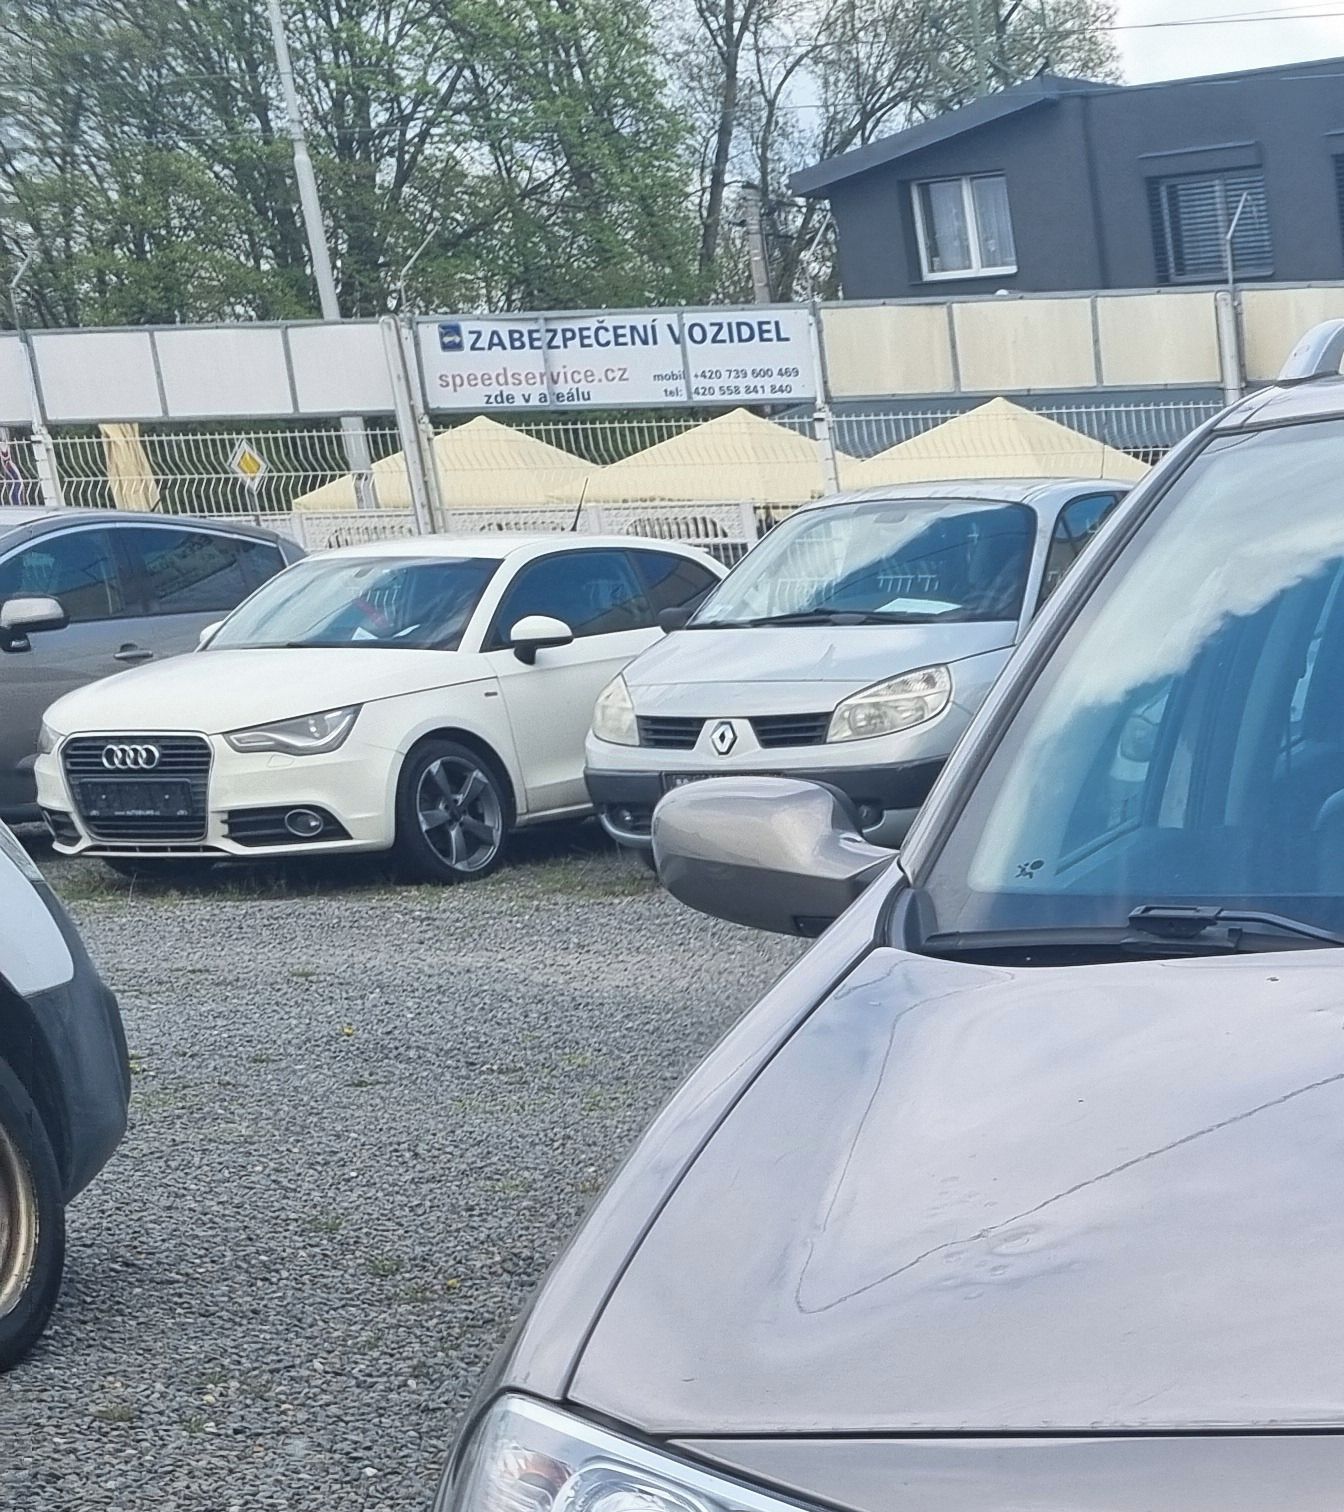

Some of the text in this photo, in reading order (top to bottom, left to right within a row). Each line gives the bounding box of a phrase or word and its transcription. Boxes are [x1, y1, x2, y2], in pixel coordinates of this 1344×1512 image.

[468, 319, 790, 351] ZABEZPEČENÍ VOZIDEL
[438, 364, 630, 393] speedservice.cz
[726, 368, 748, 379] 739
[751, 368, 773, 378] 600
[484, 386, 592, 405] zde v aeálu
